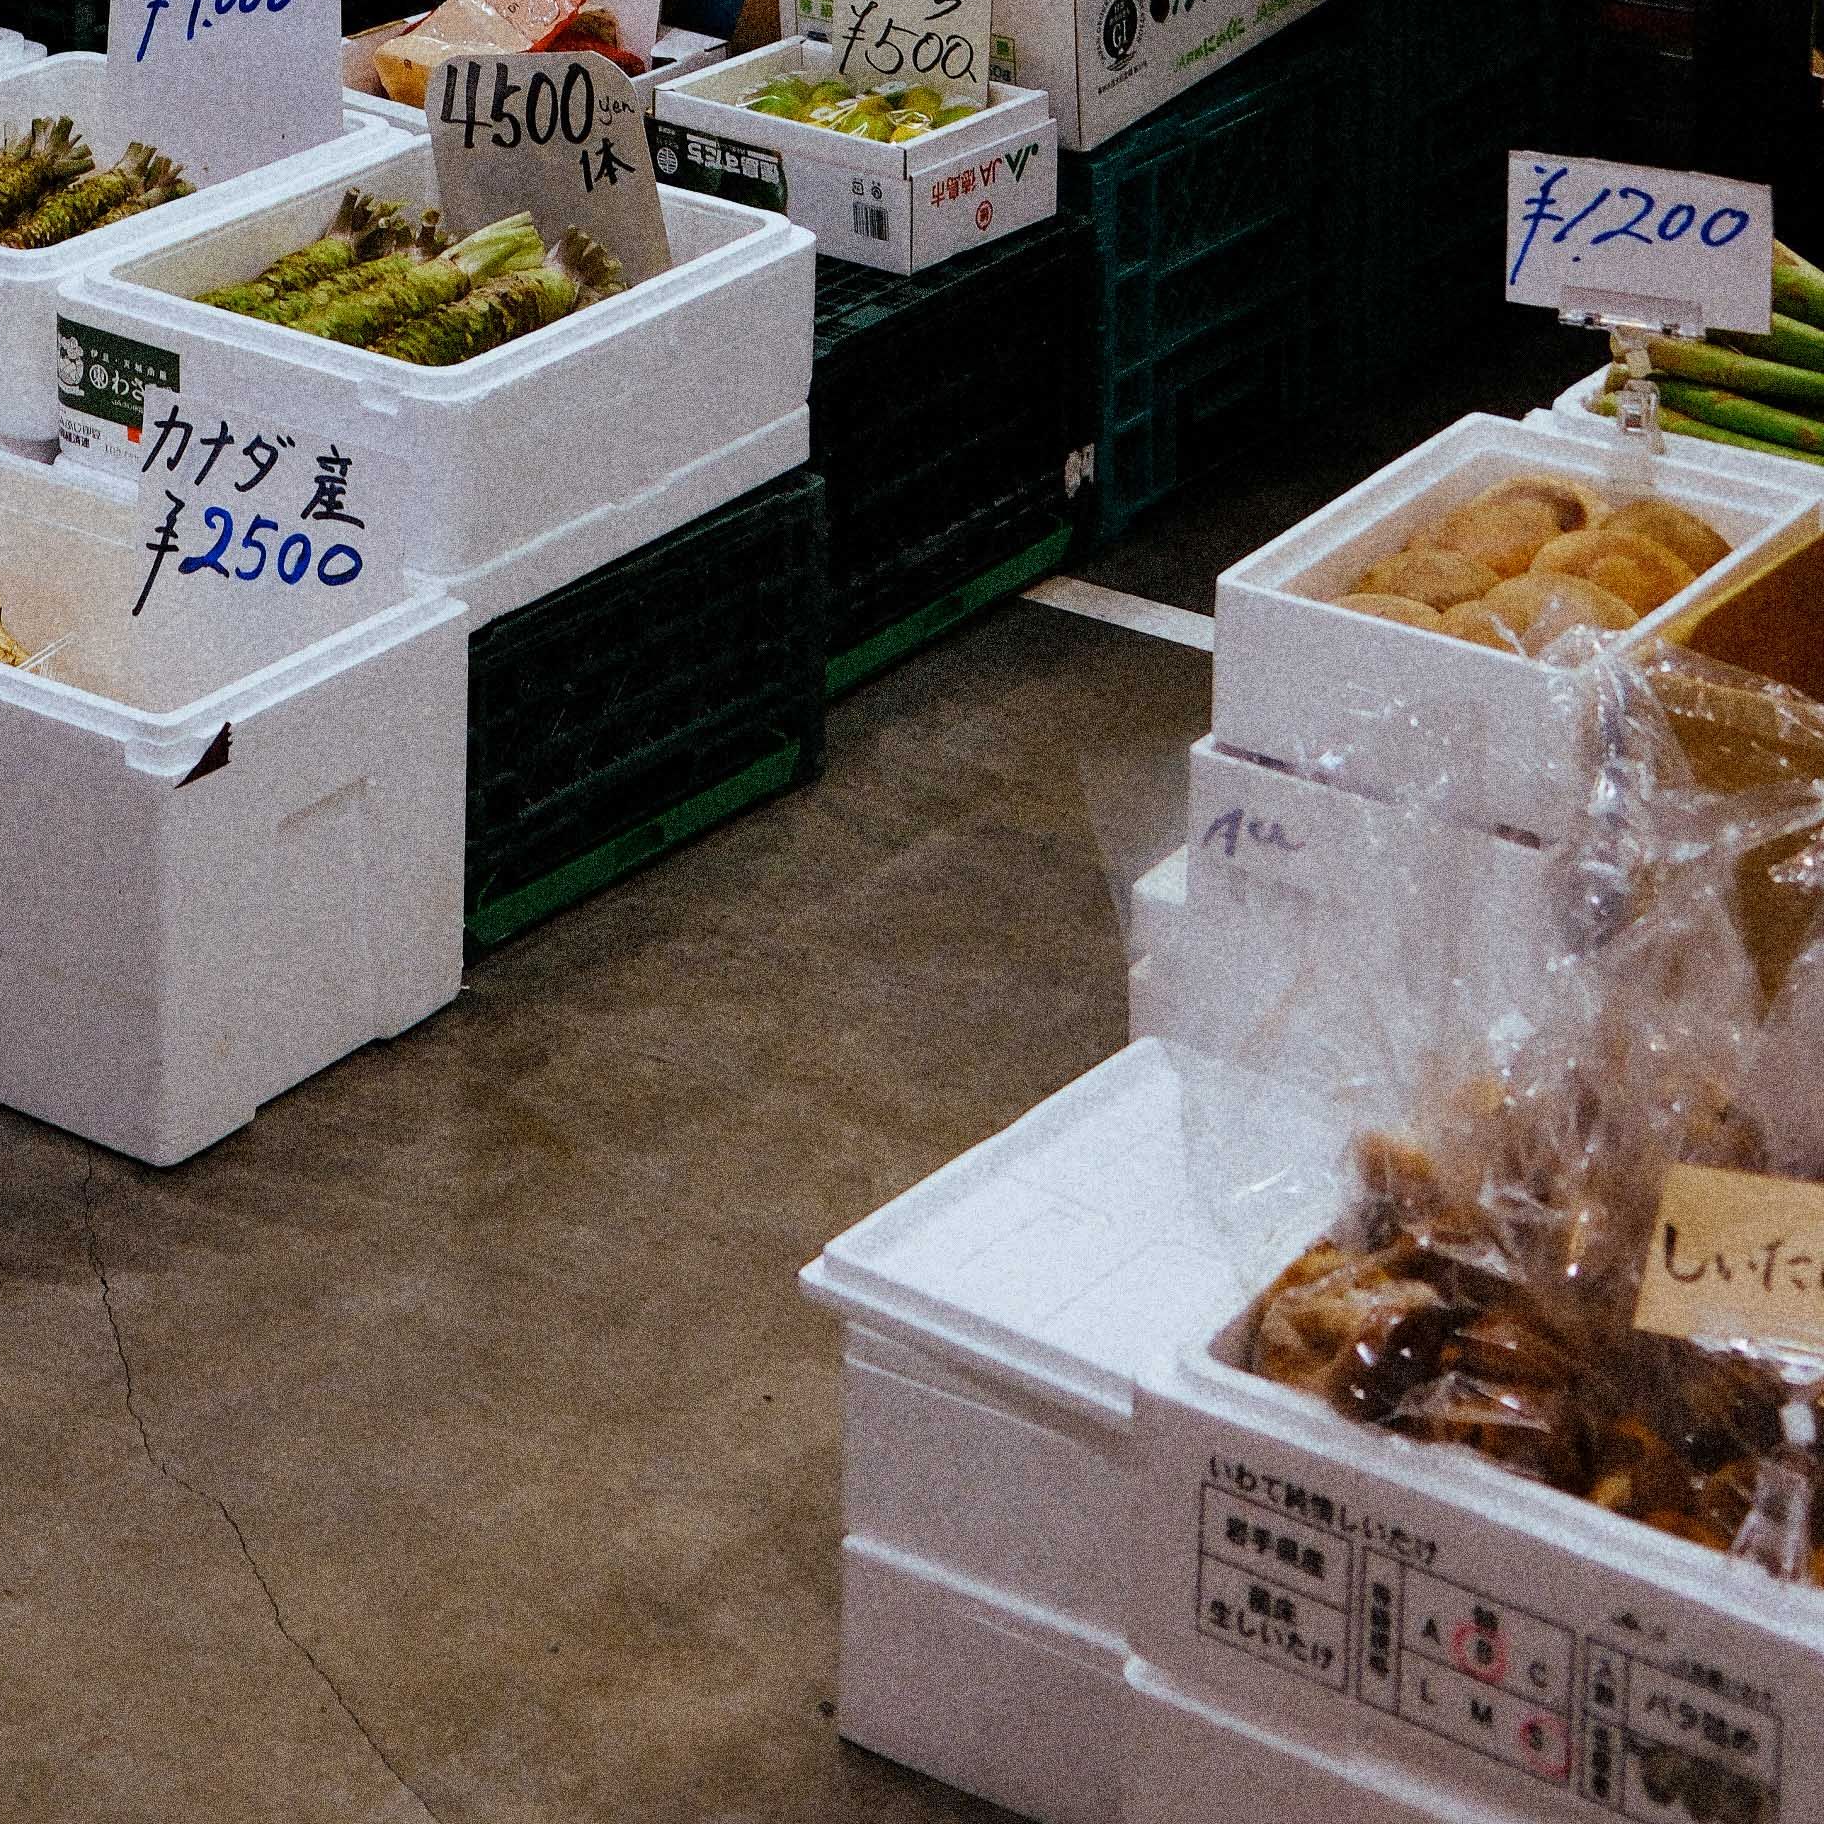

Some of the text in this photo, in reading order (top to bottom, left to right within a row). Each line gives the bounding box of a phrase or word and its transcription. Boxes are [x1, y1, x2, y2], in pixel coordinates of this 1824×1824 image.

[440, 60, 595, 150] 4500
[142, 405, 366, 530] カナダ産
[131, 490, 364, 617] ¥2500
[1664, 1218, 1824, 1295] しいた
[1209, 1598, 1335, 1671] 生しいたけ
